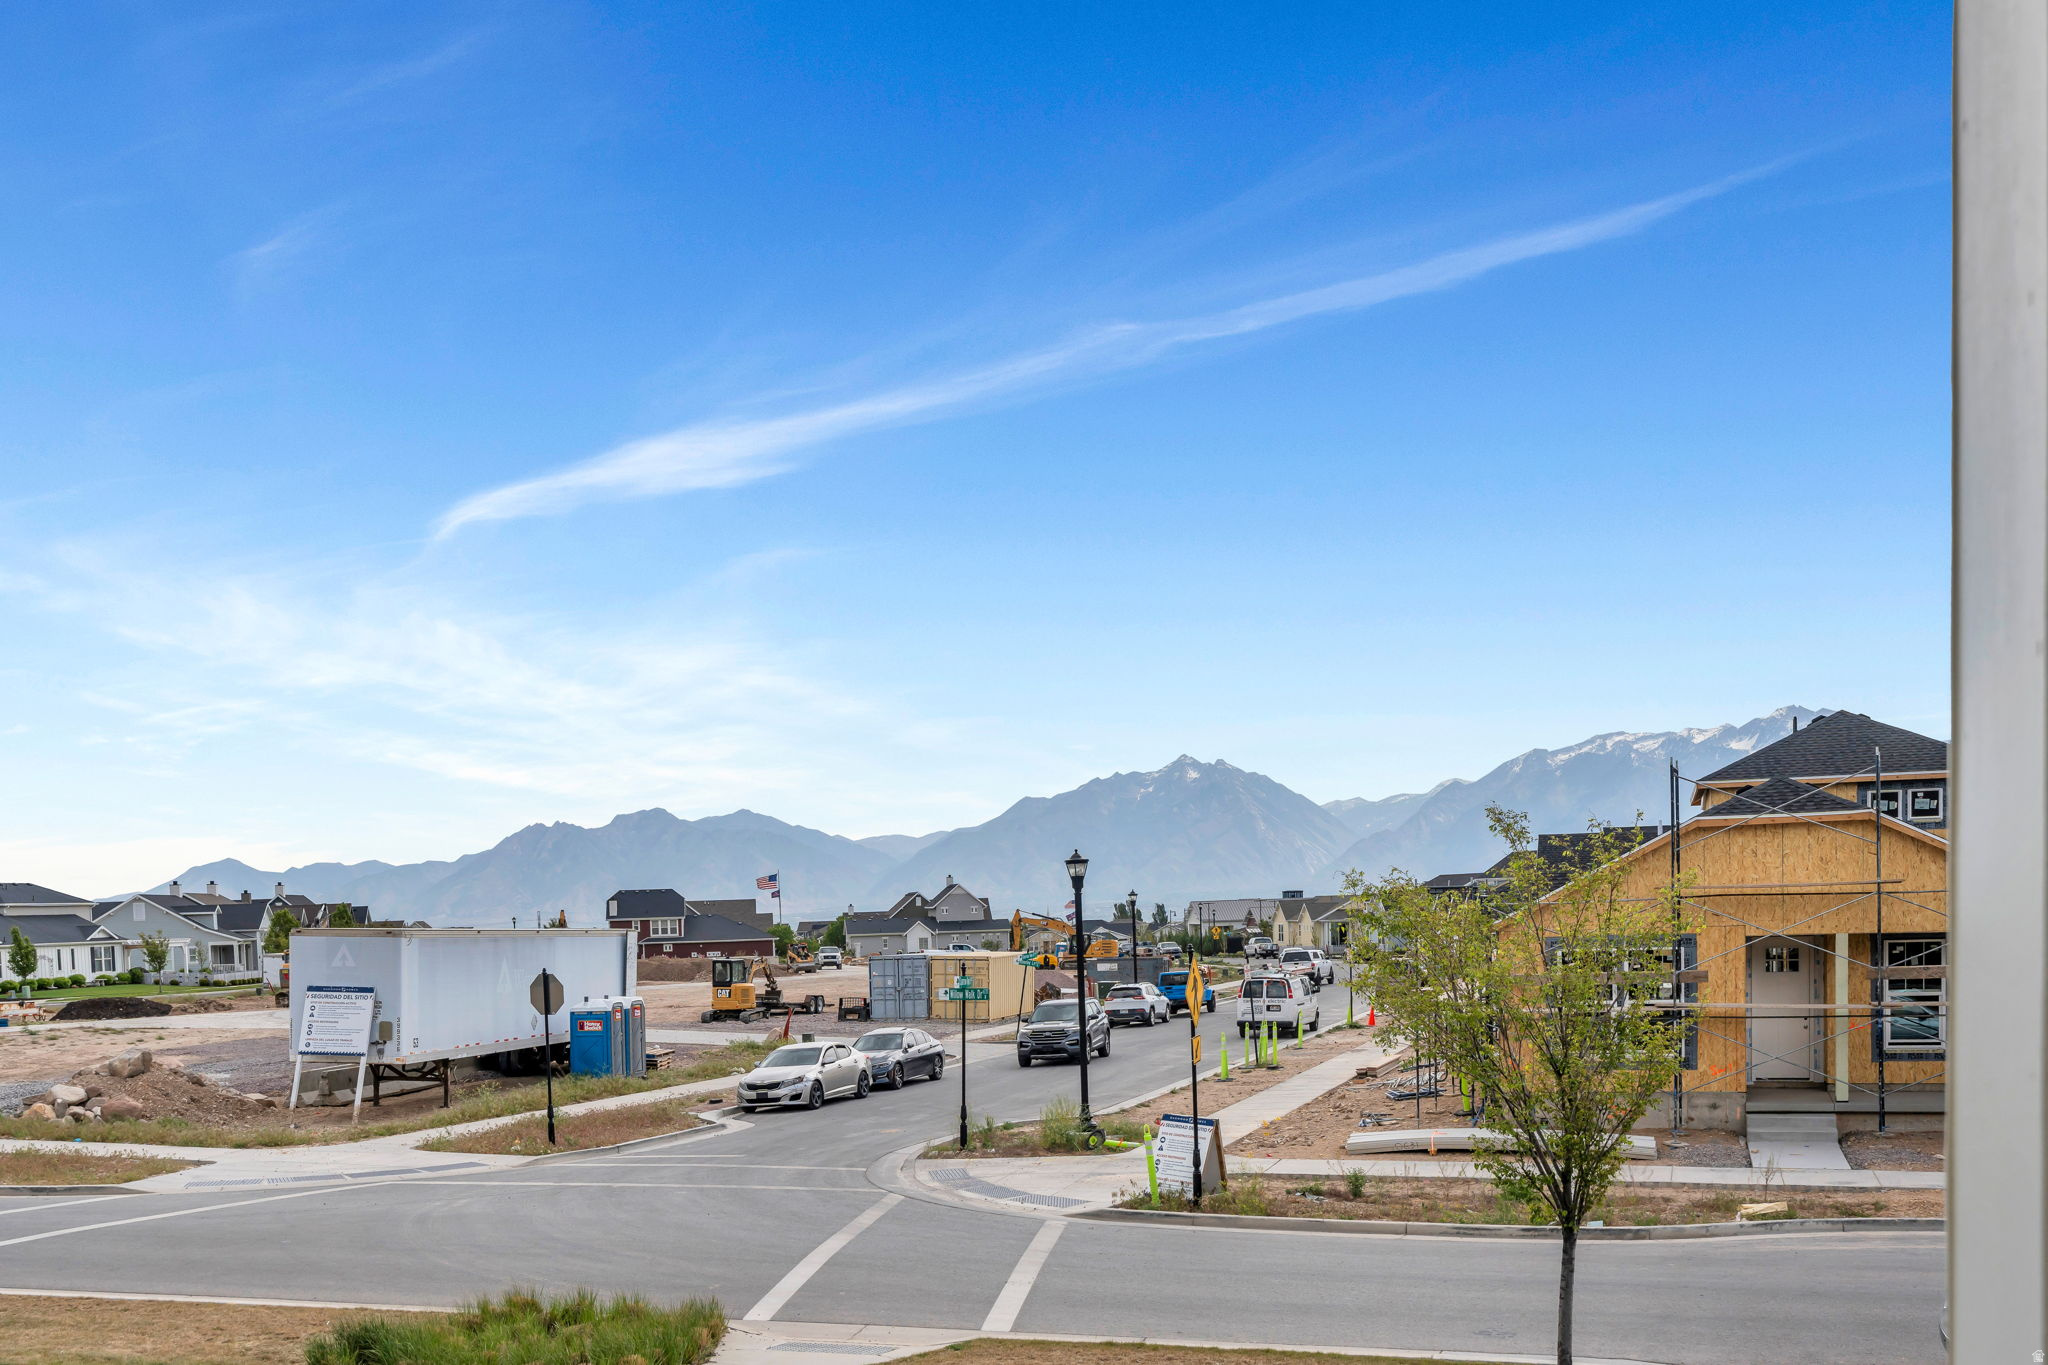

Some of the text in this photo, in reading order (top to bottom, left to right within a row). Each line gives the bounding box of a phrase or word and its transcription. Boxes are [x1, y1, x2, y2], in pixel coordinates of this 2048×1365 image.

[717, 989, 730, 998] CAT
[950, 989, 964, 999] Willow
[965, 989, 976, 999] Walk
[976, 989, 983, 999] Dr
